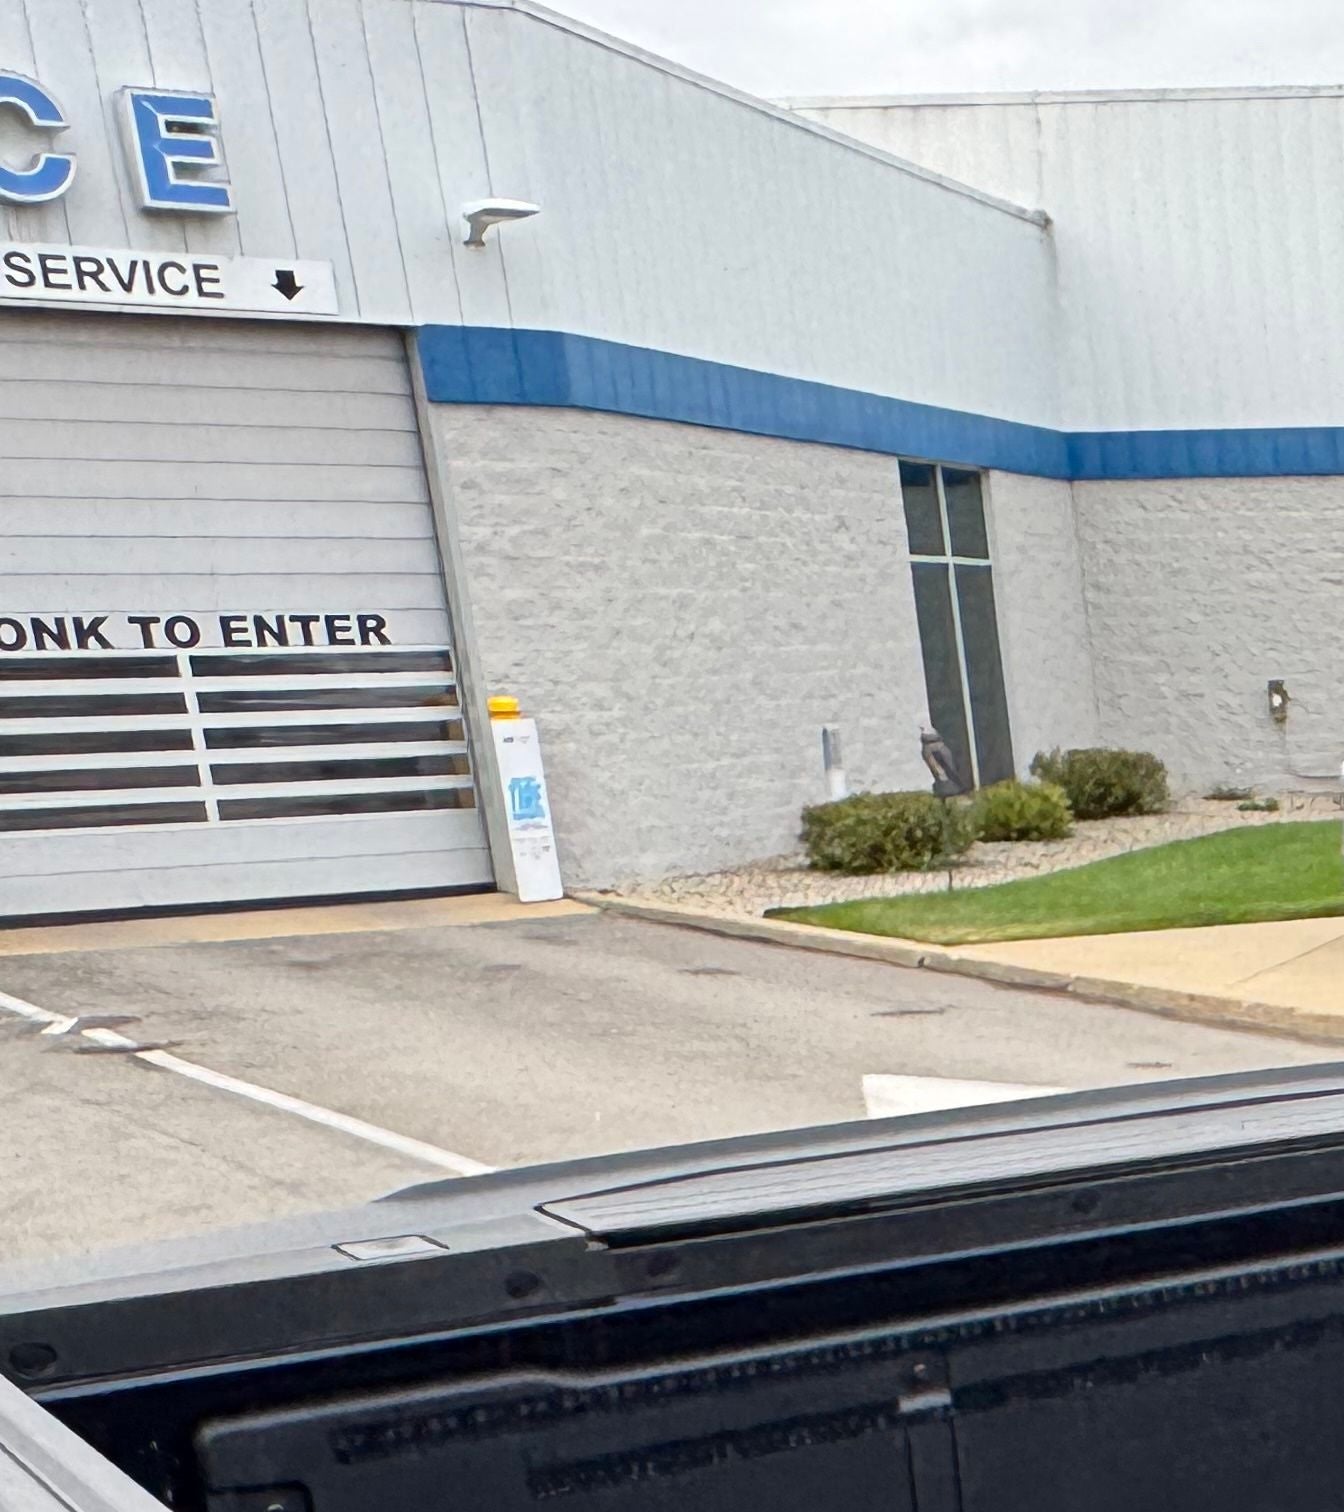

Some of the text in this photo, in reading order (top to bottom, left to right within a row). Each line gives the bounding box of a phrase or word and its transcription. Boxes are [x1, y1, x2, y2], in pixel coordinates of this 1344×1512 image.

[2, 250, 225, 299] SERVICE
[0, 614, 392, 652] ONK TO ENTER
